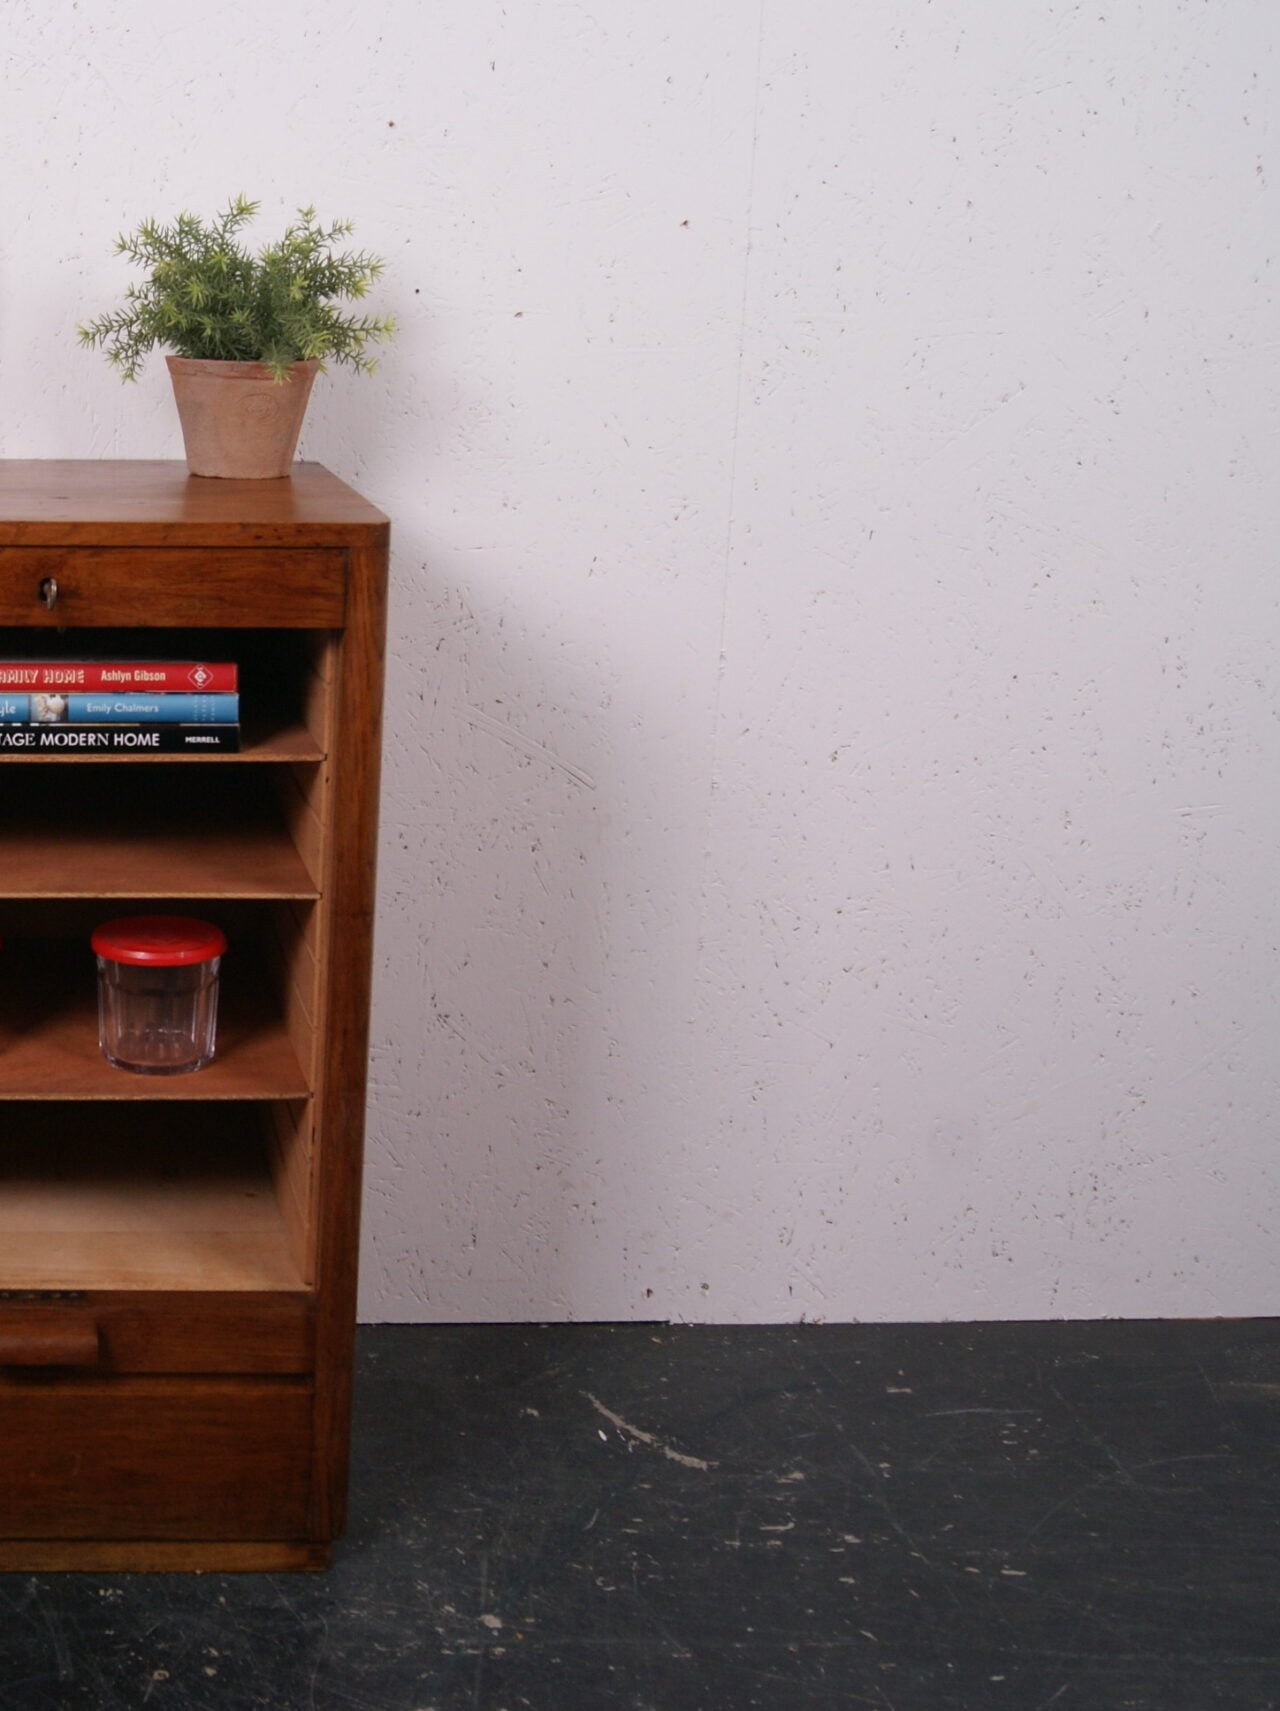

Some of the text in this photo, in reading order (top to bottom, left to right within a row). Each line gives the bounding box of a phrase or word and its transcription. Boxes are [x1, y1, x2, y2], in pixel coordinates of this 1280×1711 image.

[43, 669, 85, 684] HOME
[100, 669, 166, 682] Ashlyn Gibson
[87, 703, 159, 714] Emily Chalmers
[40, 732, 109, 747] MODERN
[113, 732, 160, 747] HOME
[185, 736, 221, 744] MERRELL
